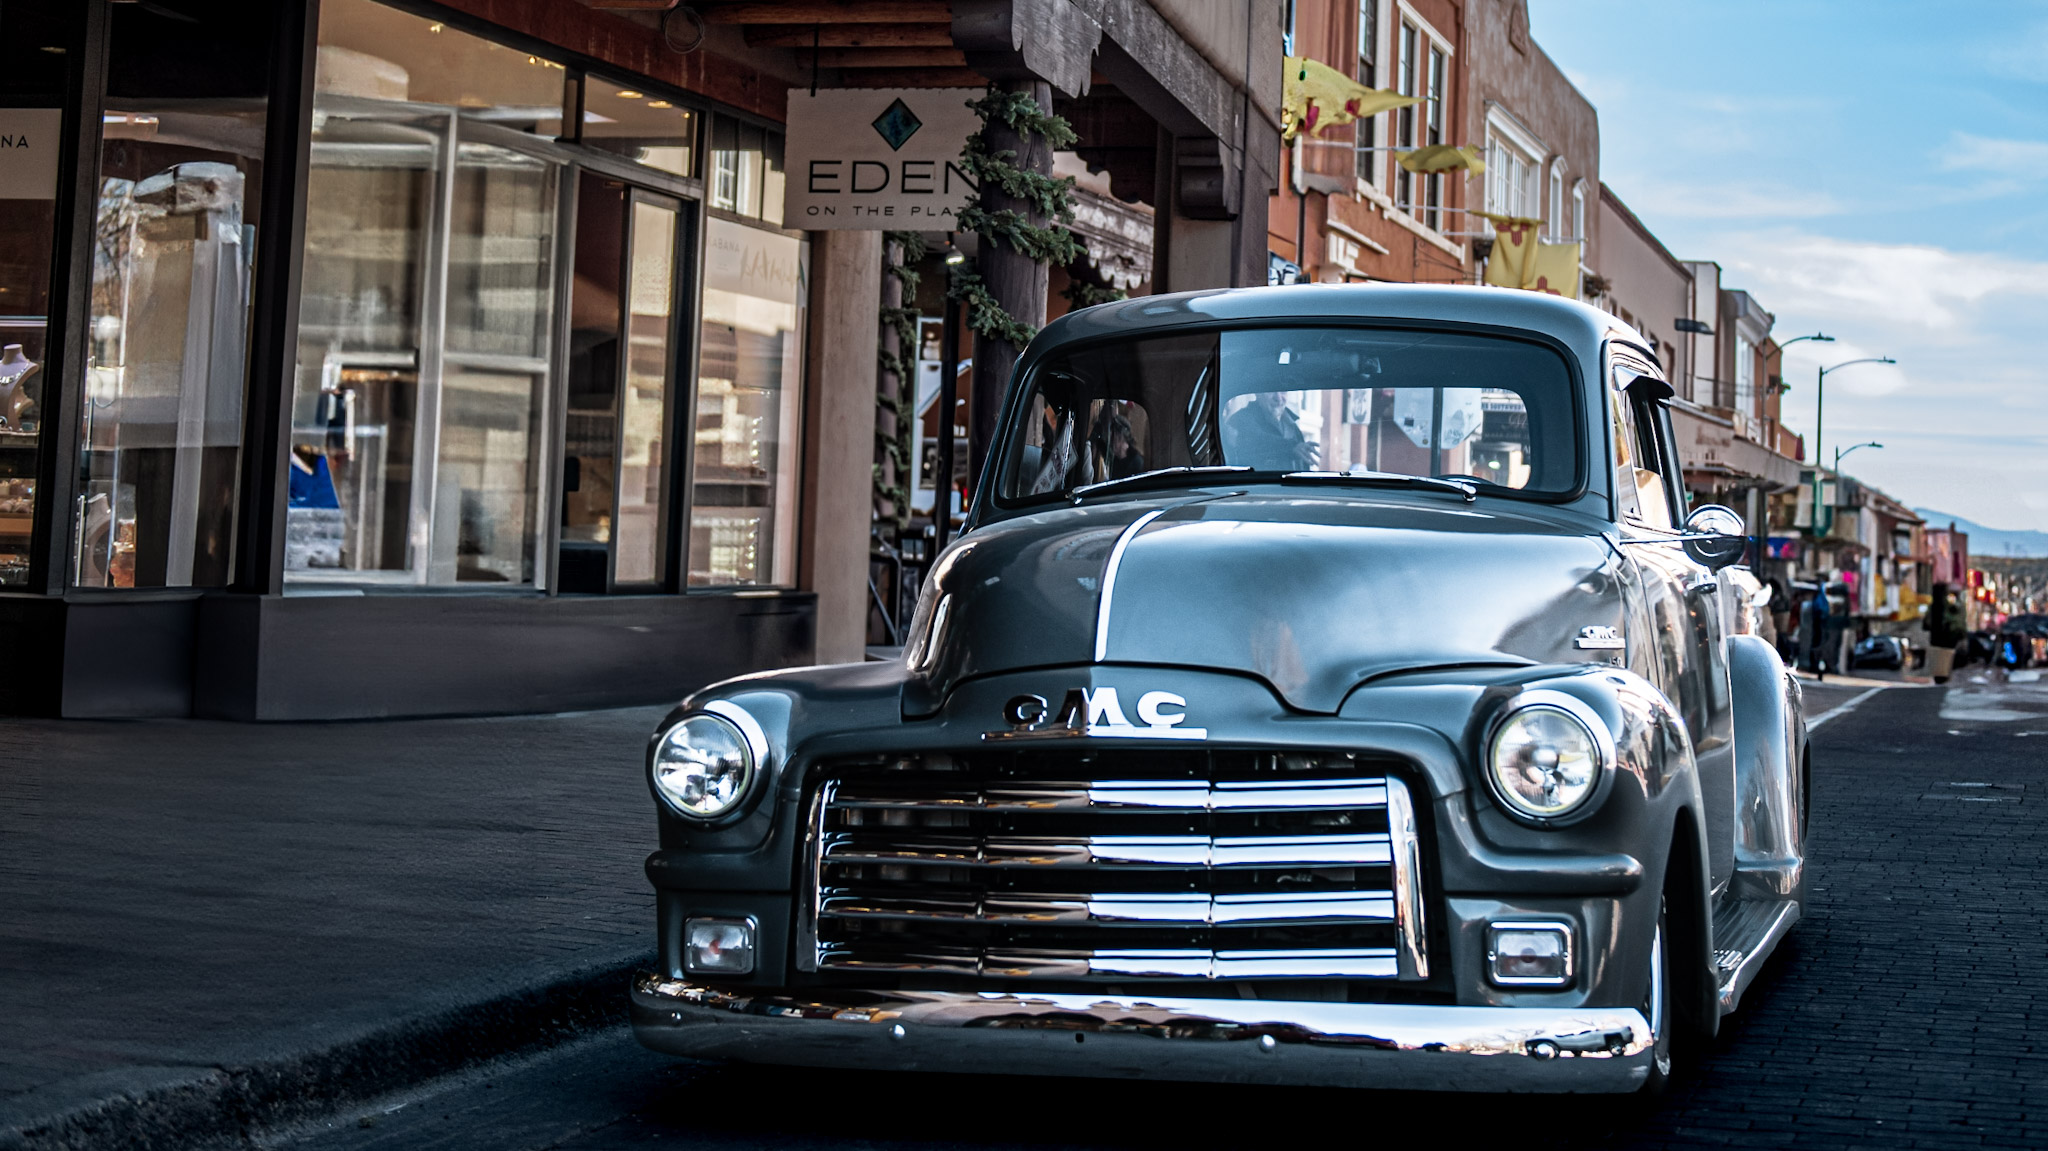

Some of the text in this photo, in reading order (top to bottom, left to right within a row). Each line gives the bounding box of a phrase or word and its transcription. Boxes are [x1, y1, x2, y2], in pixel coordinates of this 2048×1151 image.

[808, 160, 981, 194] EDEN
[806, 205, 837, 217] ON
[853, 205, 895, 217] THE
[1002, 687, 1187, 728] GMC
